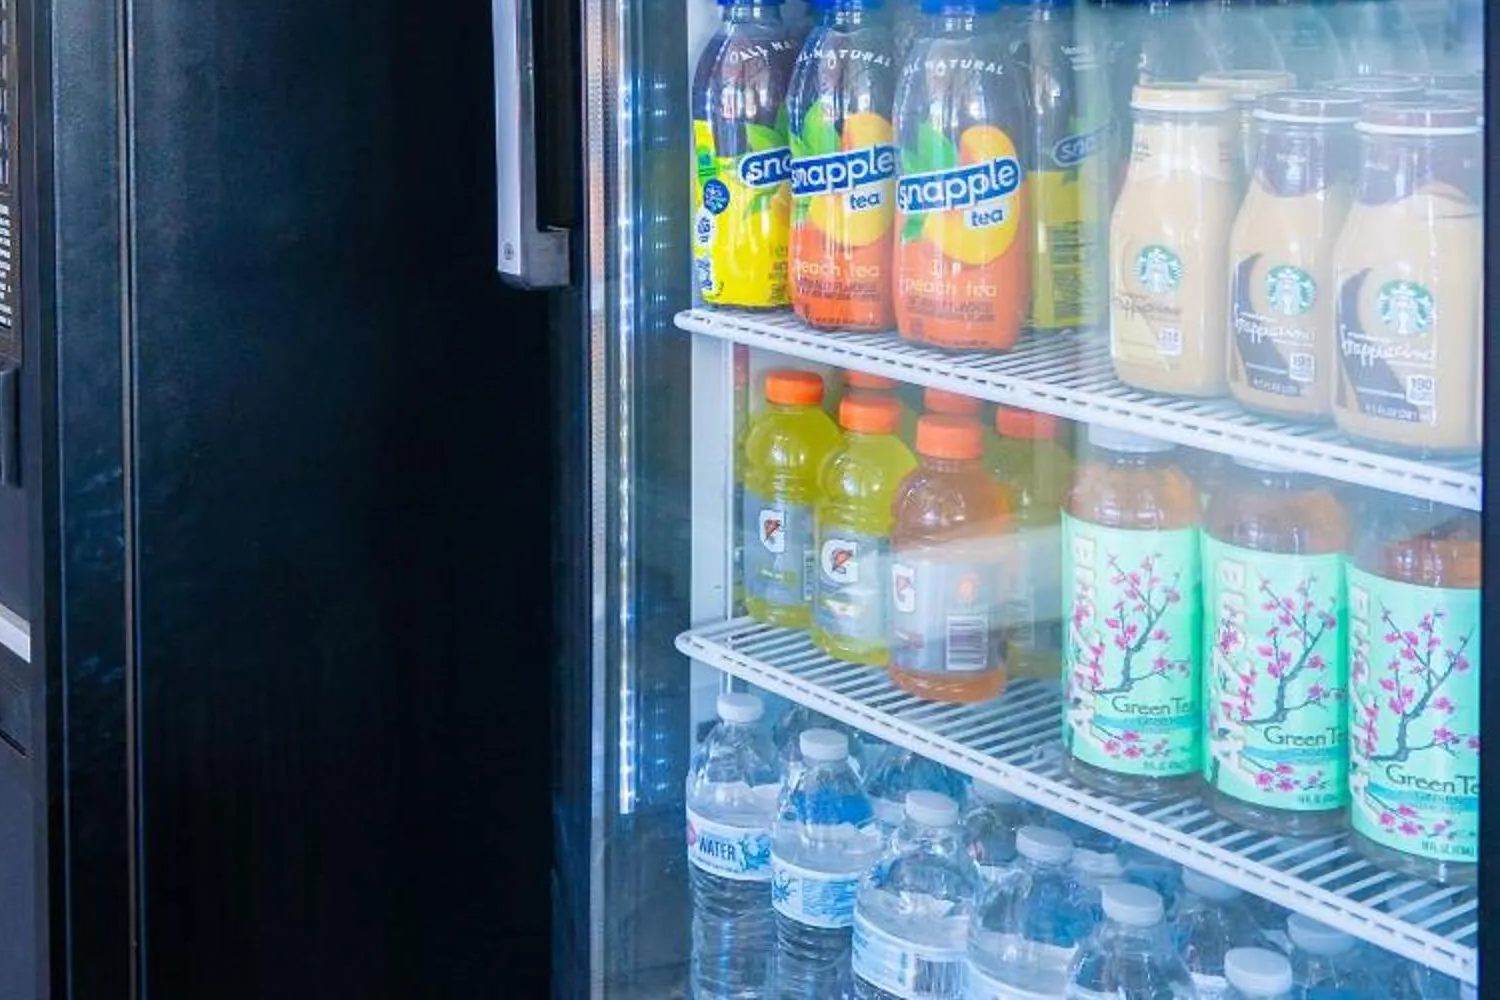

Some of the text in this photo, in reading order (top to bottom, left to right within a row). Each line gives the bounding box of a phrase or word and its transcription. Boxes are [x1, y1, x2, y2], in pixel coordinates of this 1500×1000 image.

[924, 57, 1004, 76] NATURAL
[898, 158, 1016, 211] snapple
[850, 191, 880, 210] tea
[971, 206, 1004, 226] tea
[1111, 695, 1171, 715] Green
[1263, 725, 1327, 747] Green
[1386, 763, 1456, 794] Green
